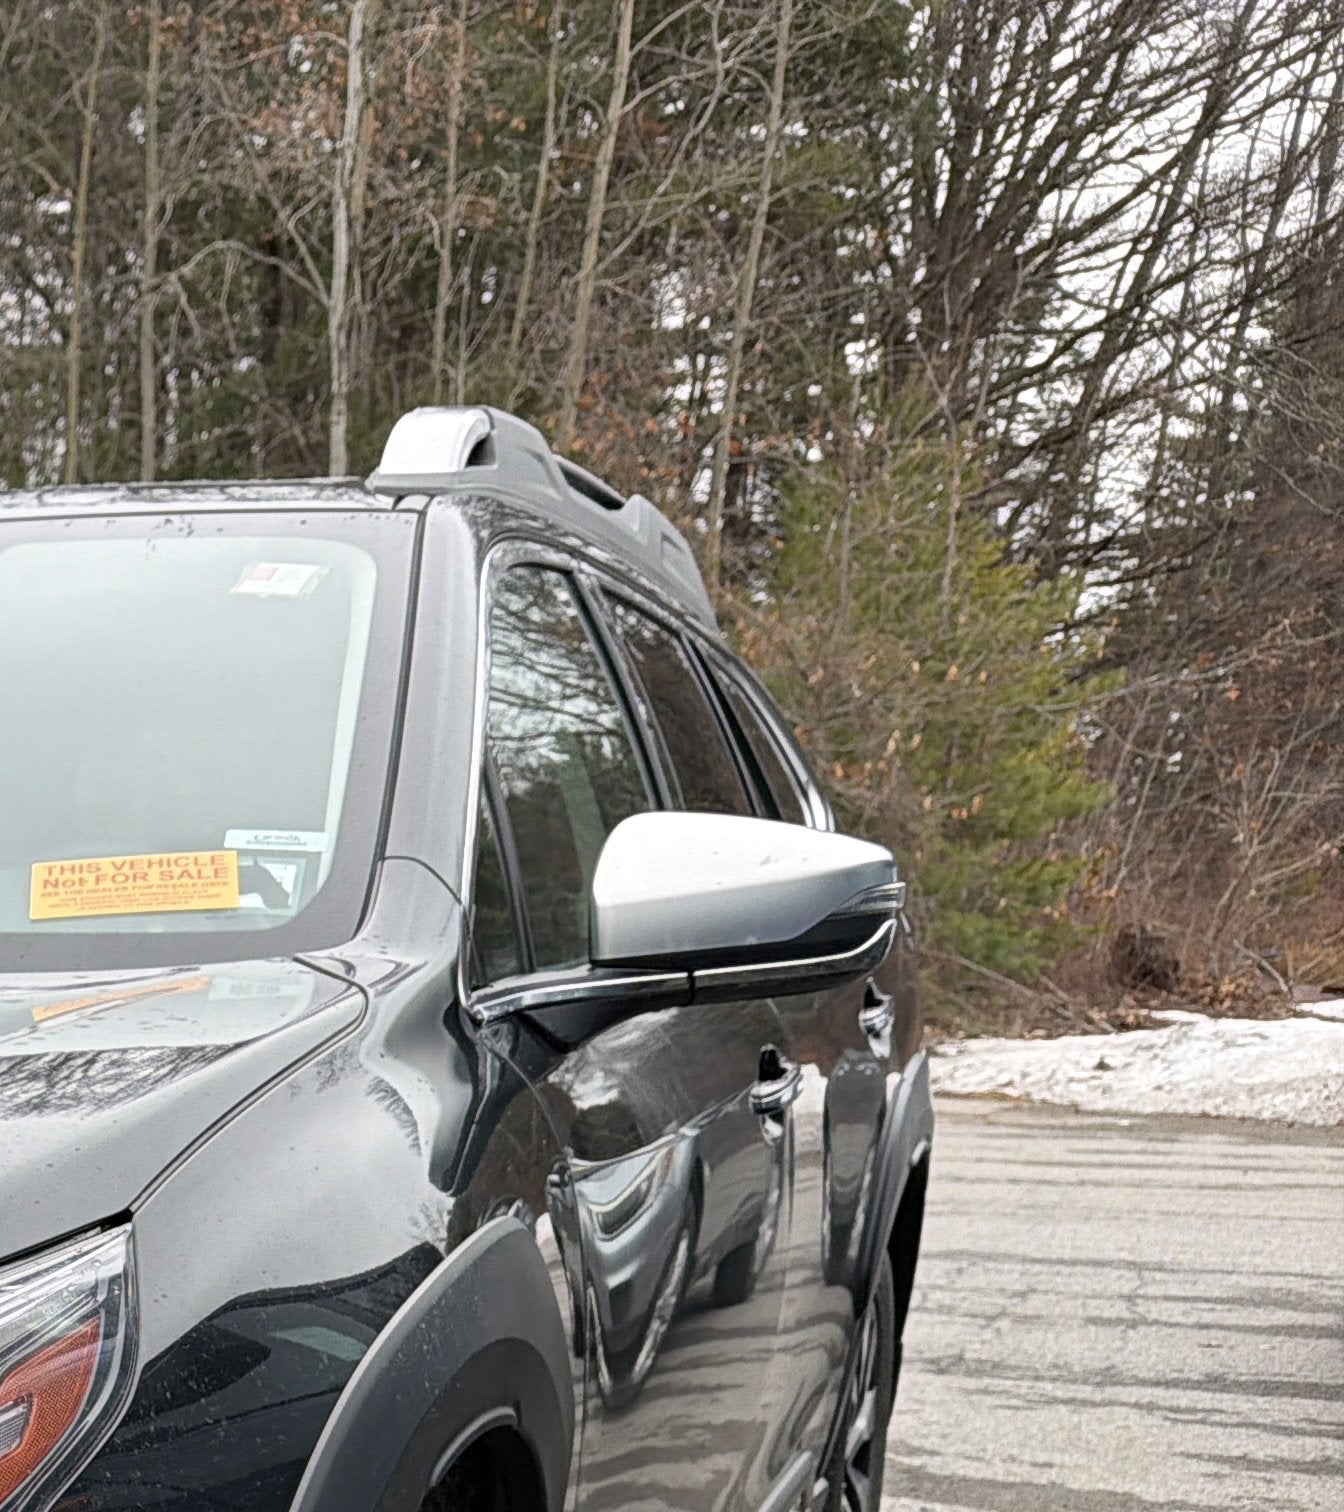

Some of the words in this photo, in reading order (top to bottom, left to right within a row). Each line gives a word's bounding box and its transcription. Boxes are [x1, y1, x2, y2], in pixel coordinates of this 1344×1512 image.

[43, 862, 101, 877] THIS
[111, 854, 226, 871] VEHICLE
[42, 877, 87, 889] Not
[95, 871, 149, 886] FOR
[159, 866, 229, 881] SALE
